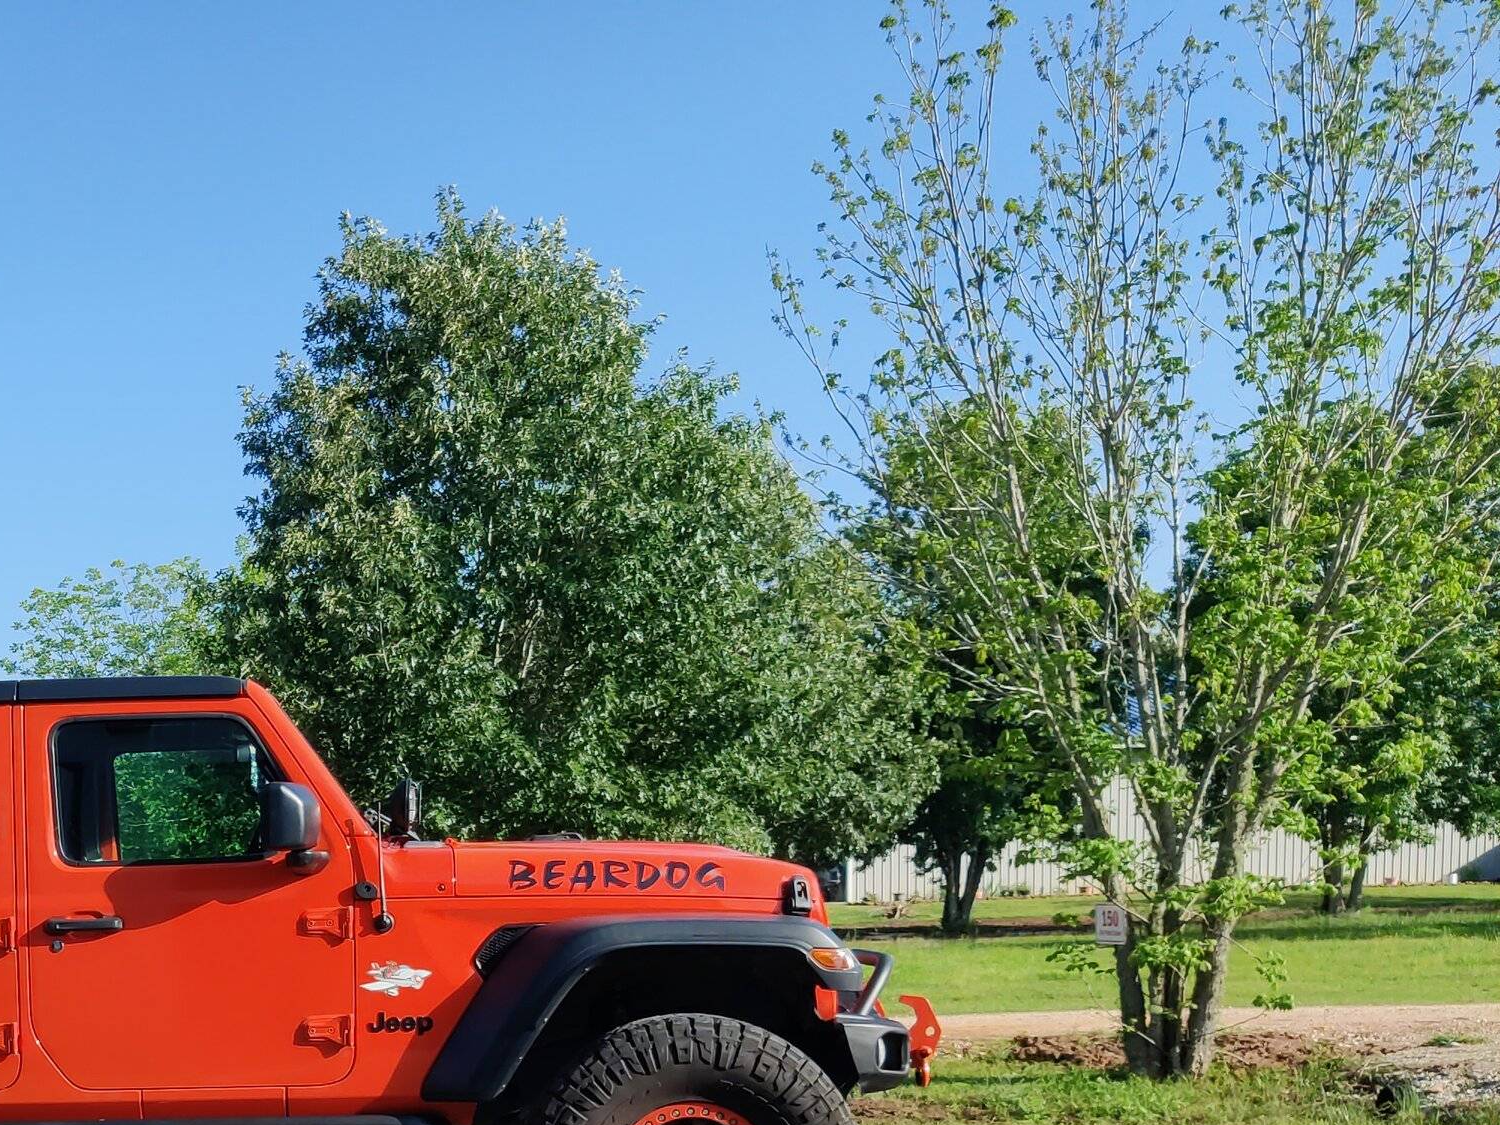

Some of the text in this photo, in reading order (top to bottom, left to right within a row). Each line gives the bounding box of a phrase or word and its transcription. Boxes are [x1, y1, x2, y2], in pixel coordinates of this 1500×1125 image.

[509, 860, 725, 893] BEARDOG
[1102, 910, 1119, 927] 150
[366, 1012, 434, 1036] Jeep
